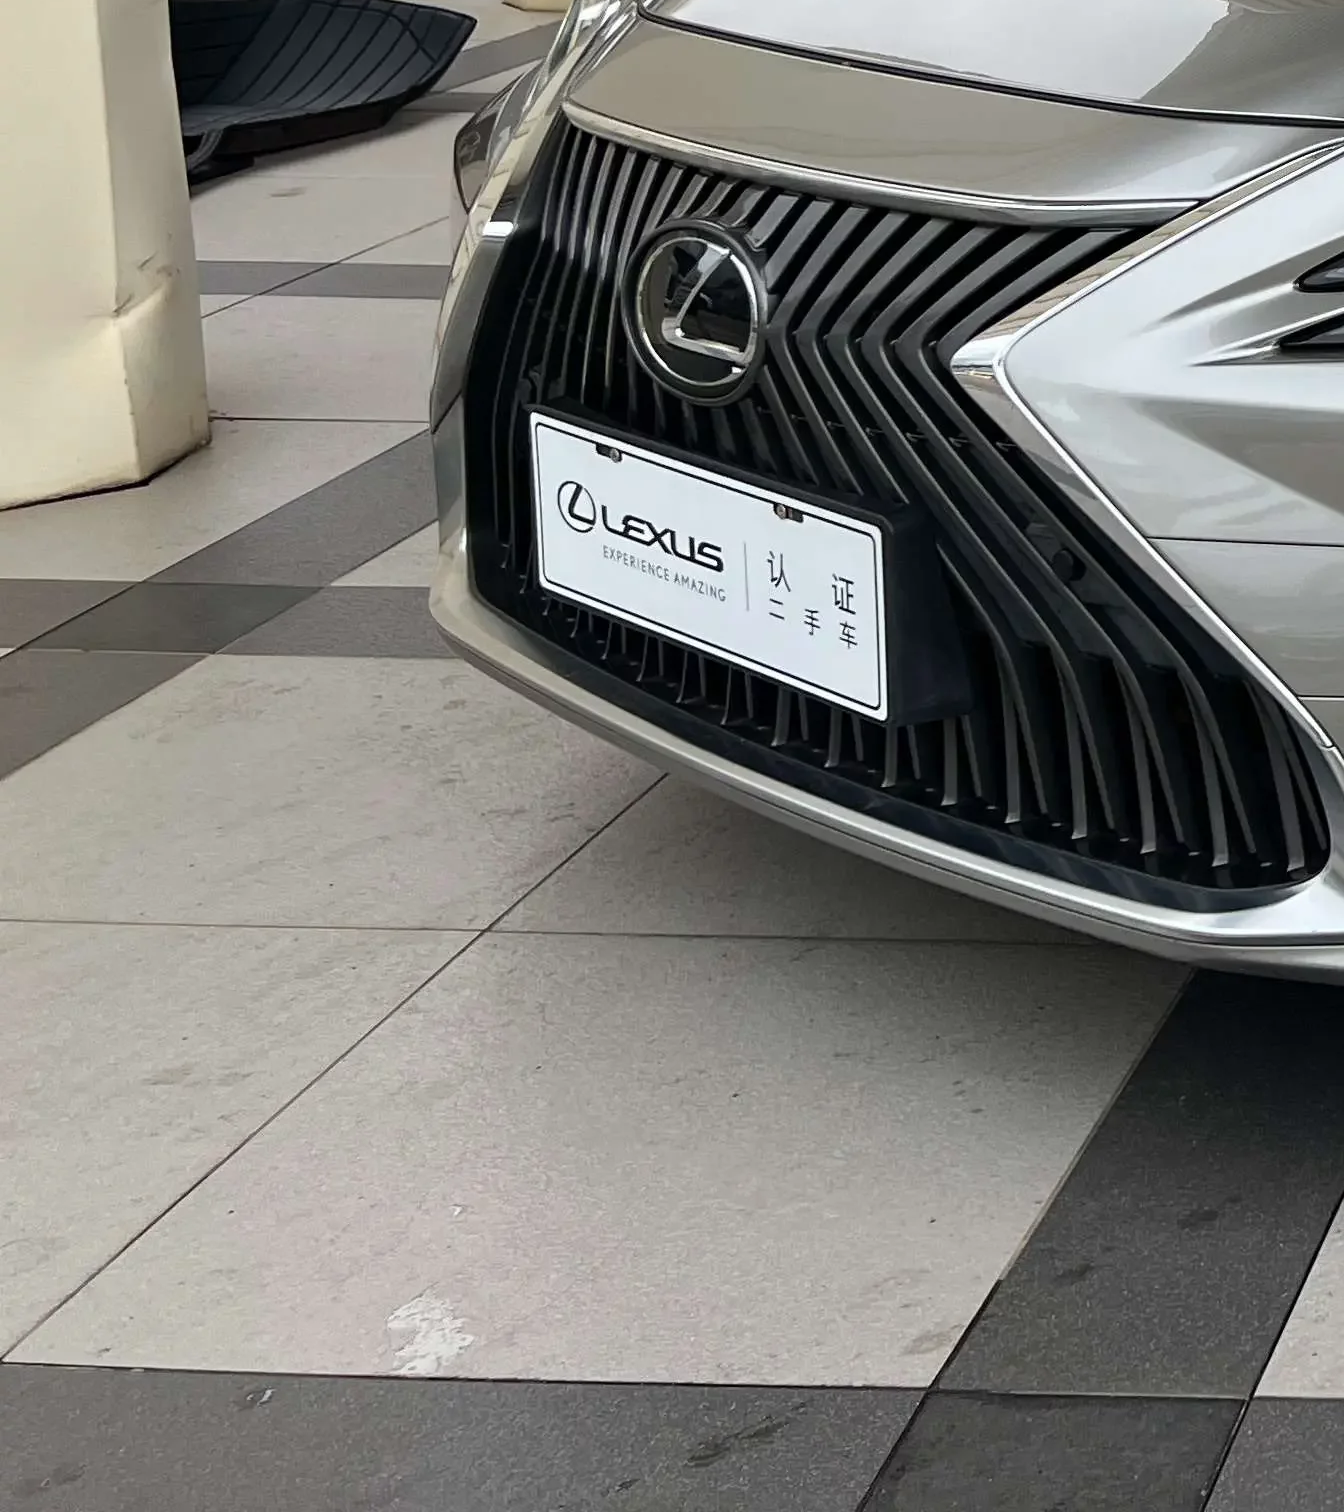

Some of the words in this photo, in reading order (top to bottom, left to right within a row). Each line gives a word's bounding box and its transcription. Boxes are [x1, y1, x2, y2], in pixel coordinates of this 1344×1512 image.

[600, 503, 725, 573] LEXUS
[602, 544, 671, 584] EXPERIENCE
[673, 570, 727, 603] AMAZING
[766, 550, 857, 616] 认证
[768, 598, 859, 650] 二手车
